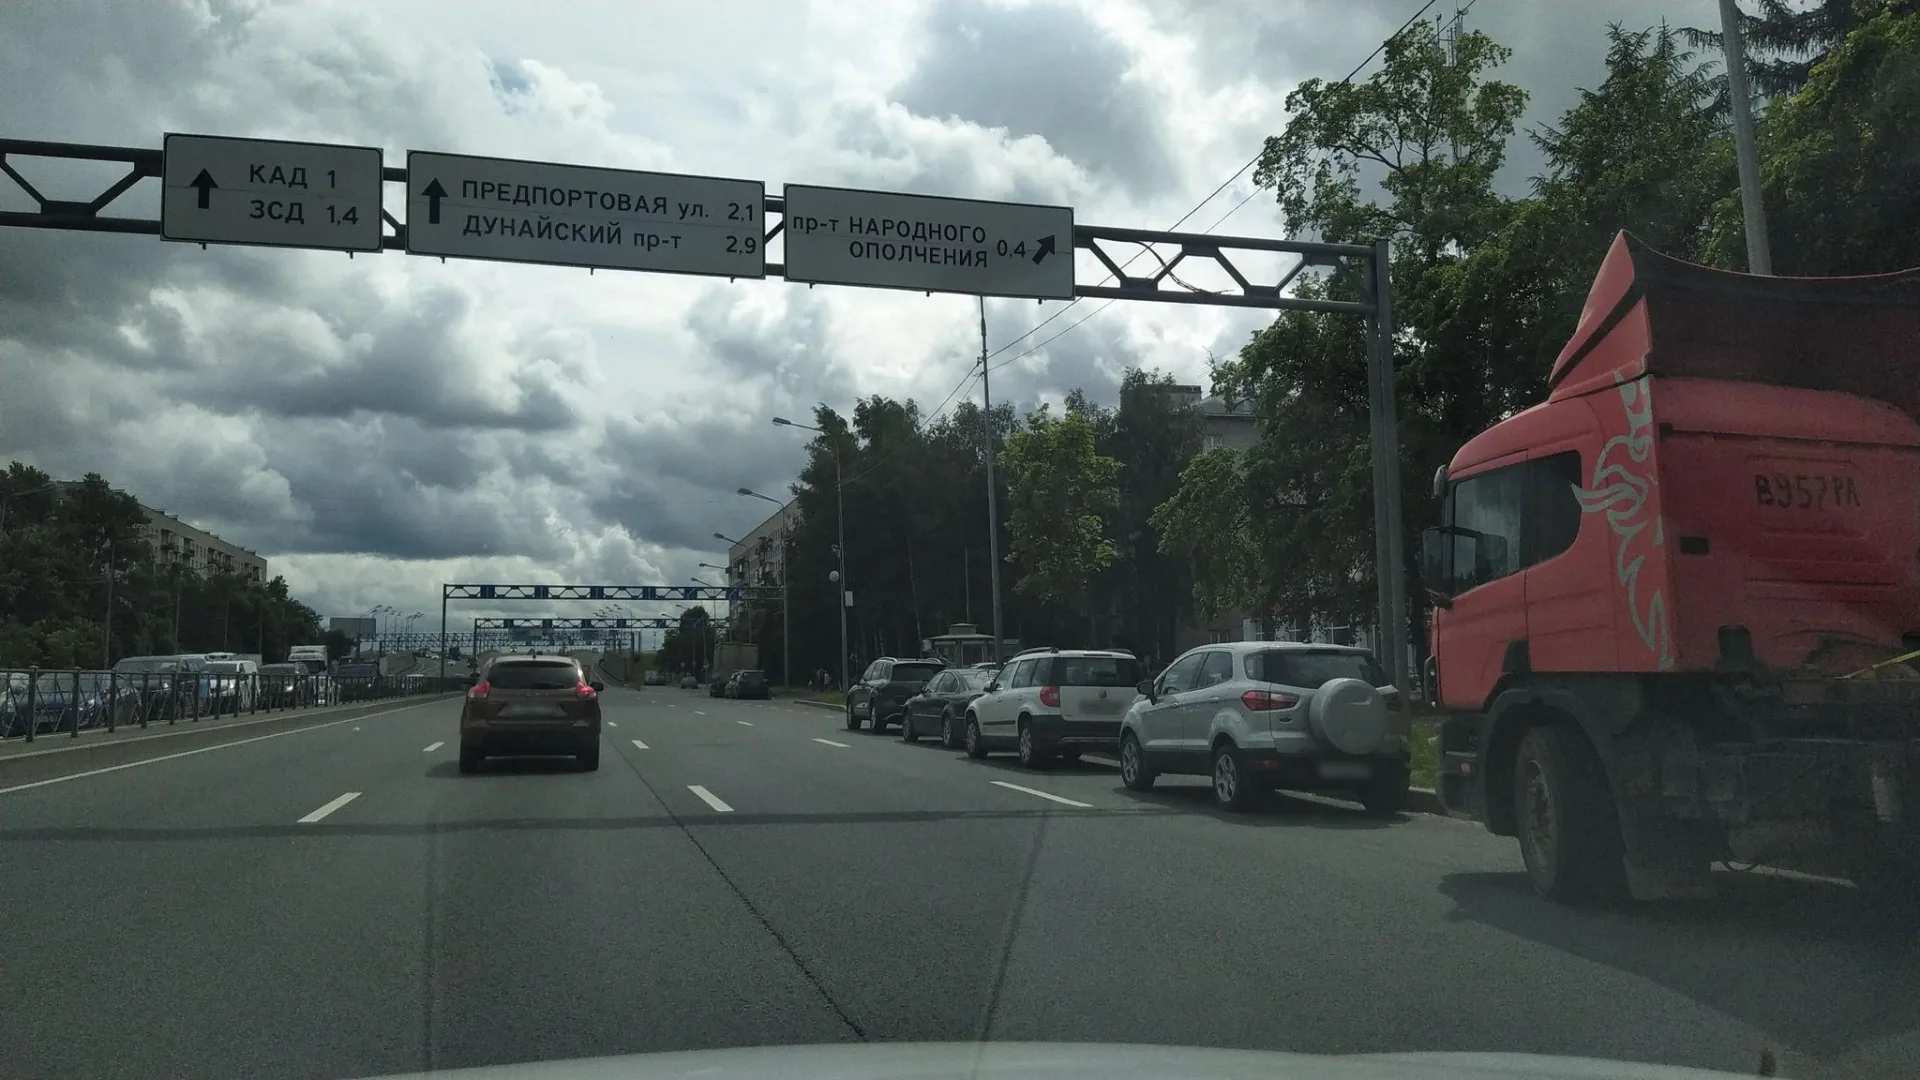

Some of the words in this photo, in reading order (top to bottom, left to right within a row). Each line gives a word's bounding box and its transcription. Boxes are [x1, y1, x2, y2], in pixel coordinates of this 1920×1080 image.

[249, 164, 308, 189] КАД
[326, 170, 336, 189] 1
[249, 200, 305, 225] ЗСД
[326, 205, 359, 226] 1,4
[461, 179, 668, 216] ПРЕДПОРТОВАЯ
[678, 201, 710, 220] ул.
[727, 202, 755, 223] 2,1
[462, 214, 622, 246] ДУНАЙСКИЙ
[633, 231, 682, 252] пр-т
[725, 235, 757, 256] 2,9
[793, 216, 840, 234] пр-т
[849, 216, 987, 243] НАРОДНОГО
[849, 241, 988, 268] ОПОЛЧЕНИЯ
[996, 239, 1027, 259] 0,4
